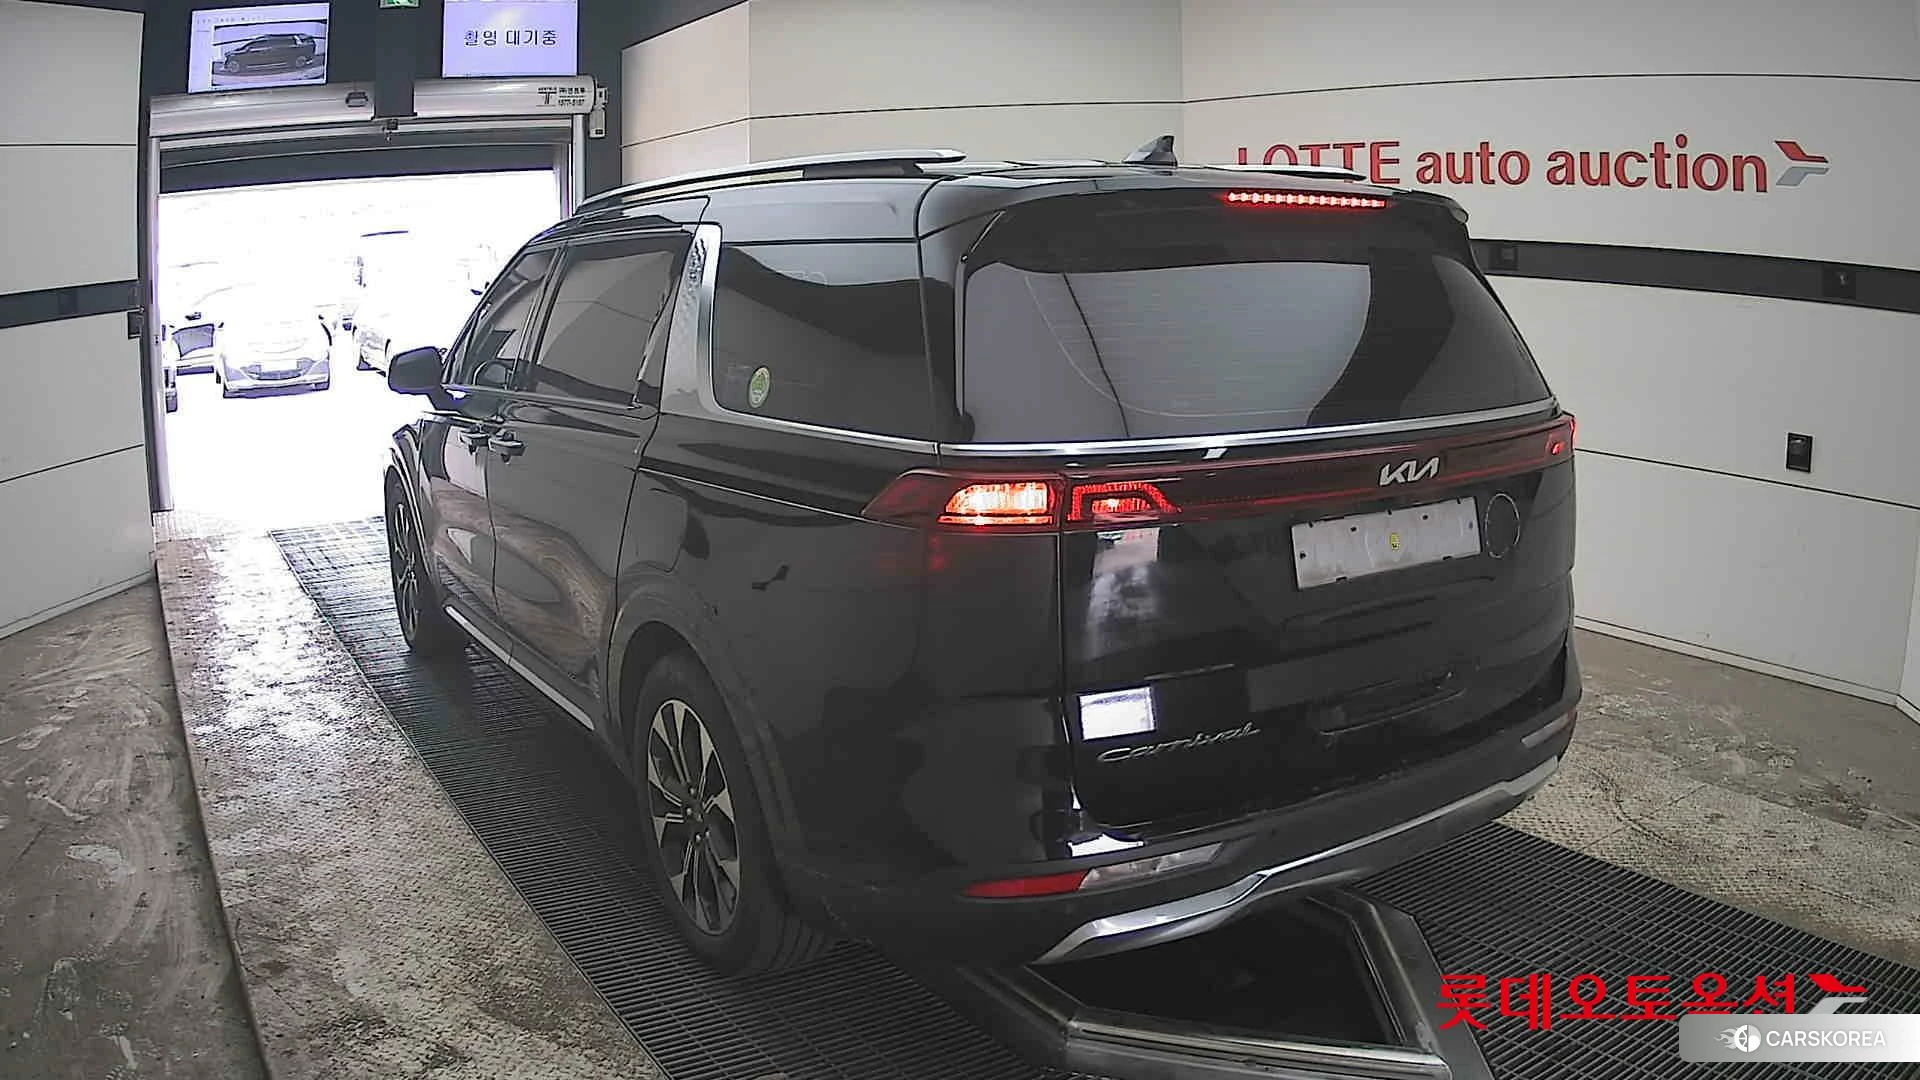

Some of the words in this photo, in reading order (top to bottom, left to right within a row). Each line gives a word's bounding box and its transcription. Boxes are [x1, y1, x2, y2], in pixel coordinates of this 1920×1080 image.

[505, 30, 558, 46] 대기중
[1415, 142, 1531, 185] auto
[1546, 134, 1769, 193] auction
[1379, 456, 1441, 487] KIA
[1096, 721, 1262, 762] Carnival
